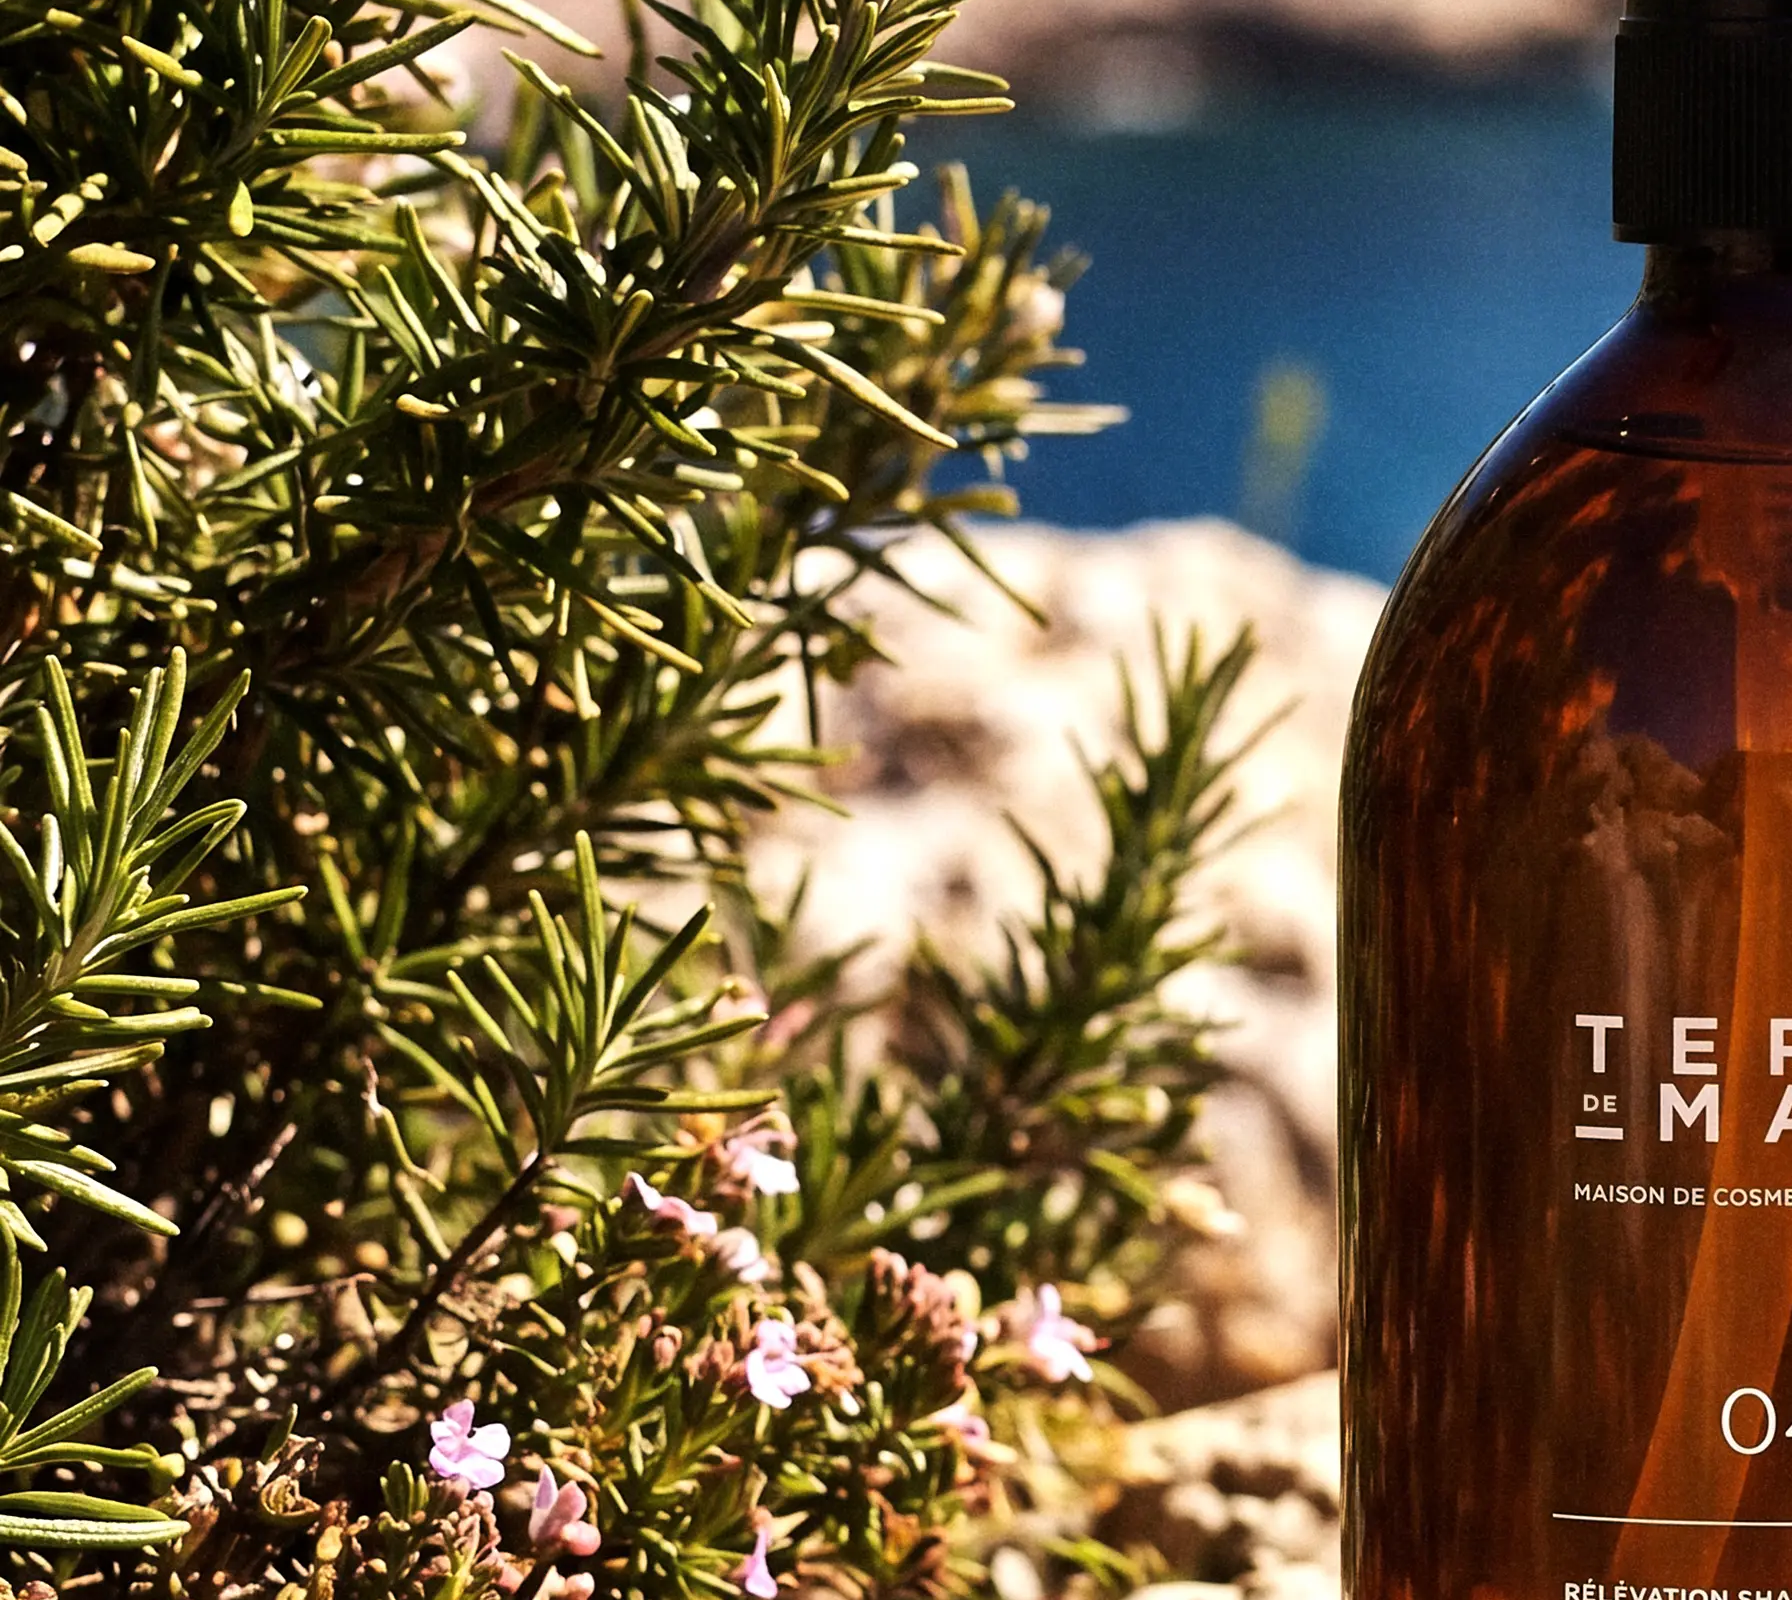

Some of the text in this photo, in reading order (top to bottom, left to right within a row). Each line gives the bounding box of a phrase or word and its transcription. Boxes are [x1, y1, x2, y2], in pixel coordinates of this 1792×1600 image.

[1583, 1094, 1618, 1113] DE
[1574, 1183, 1665, 1205] MAISON
[1673, 1187, 1706, 1206] DE
